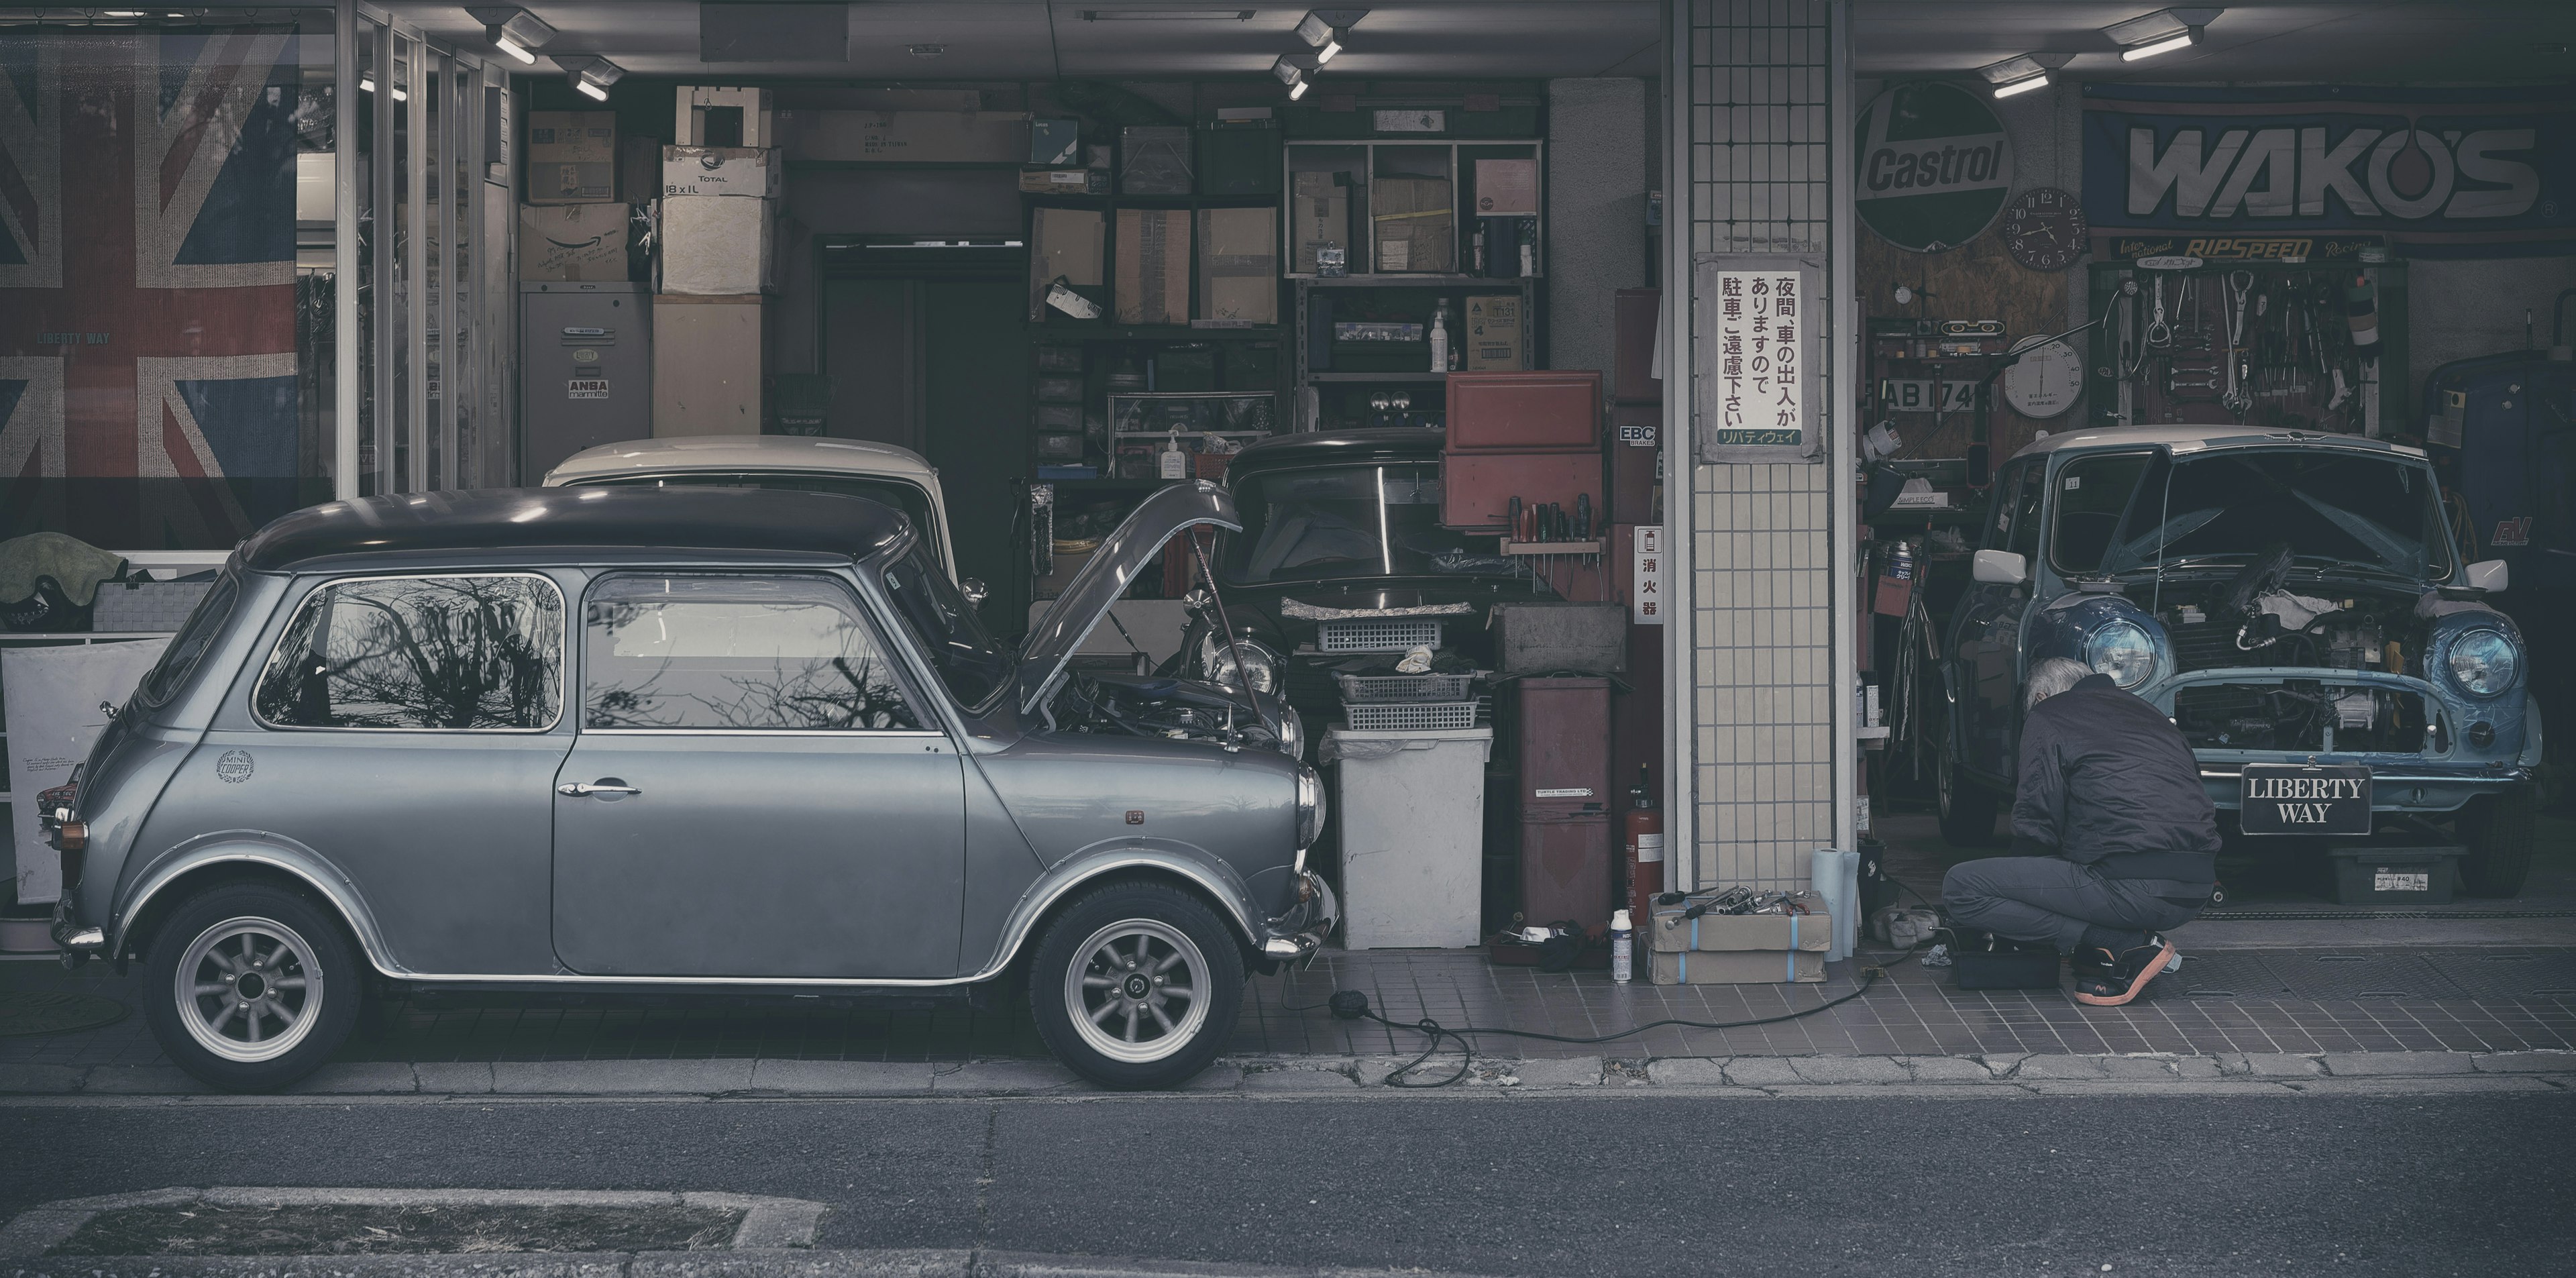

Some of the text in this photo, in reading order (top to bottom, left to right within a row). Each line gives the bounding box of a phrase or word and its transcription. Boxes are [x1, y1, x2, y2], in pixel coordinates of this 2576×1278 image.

[1867, 140, 2004, 191] Castrol
[2129, 127, 2540, 219] WAKO'S
[665, 184, 677, 194] 18
[2028, 197, 2035, 208] 11
[2041, 193, 2052, 204] 12
[2059, 196, 2063, 207] 1
[2016, 208, 2026, 220] 10
[2070, 209, 2078, 220] 2
[2012, 223, 2021, 235] 9
[2072, 223, 2080, 235] 3
[2015, 239, 2023, 250] 8
[2068, 238, 2076, 250] 4
[2120, 239, 2145, 254] Inter
[2131, 239, 2174, 258] national
[2184, 238, 2313, 258] RIPSPEED
[2028, 250, 2037, 261] 7
[2042, 254, 2050, 265] 6
[2057, 250, 2065, 262] 5
[36, 331, 110, 345] LIBERTY WAY
[1751, 278, 1770, 394] ありますので
[1722, 277, 1743, 427] 駐車ご遠慮下さい
[1776, 277, 1796, 427] 夜間、車の出入が
[570, 381, 608, 390] ANSA
[570, 390, 608, 398] marmitte
[1620, 427, 1655, 441] EBC
[1723, 430, 1794, 444] リバティウェイ
[1643, 557, 1657, 616] 消火器
[221, 763, 250, 774] COOPER
[2247, 778, 2365, 799] LIBERTY
[2277, 803, 2332, 824] WAY
